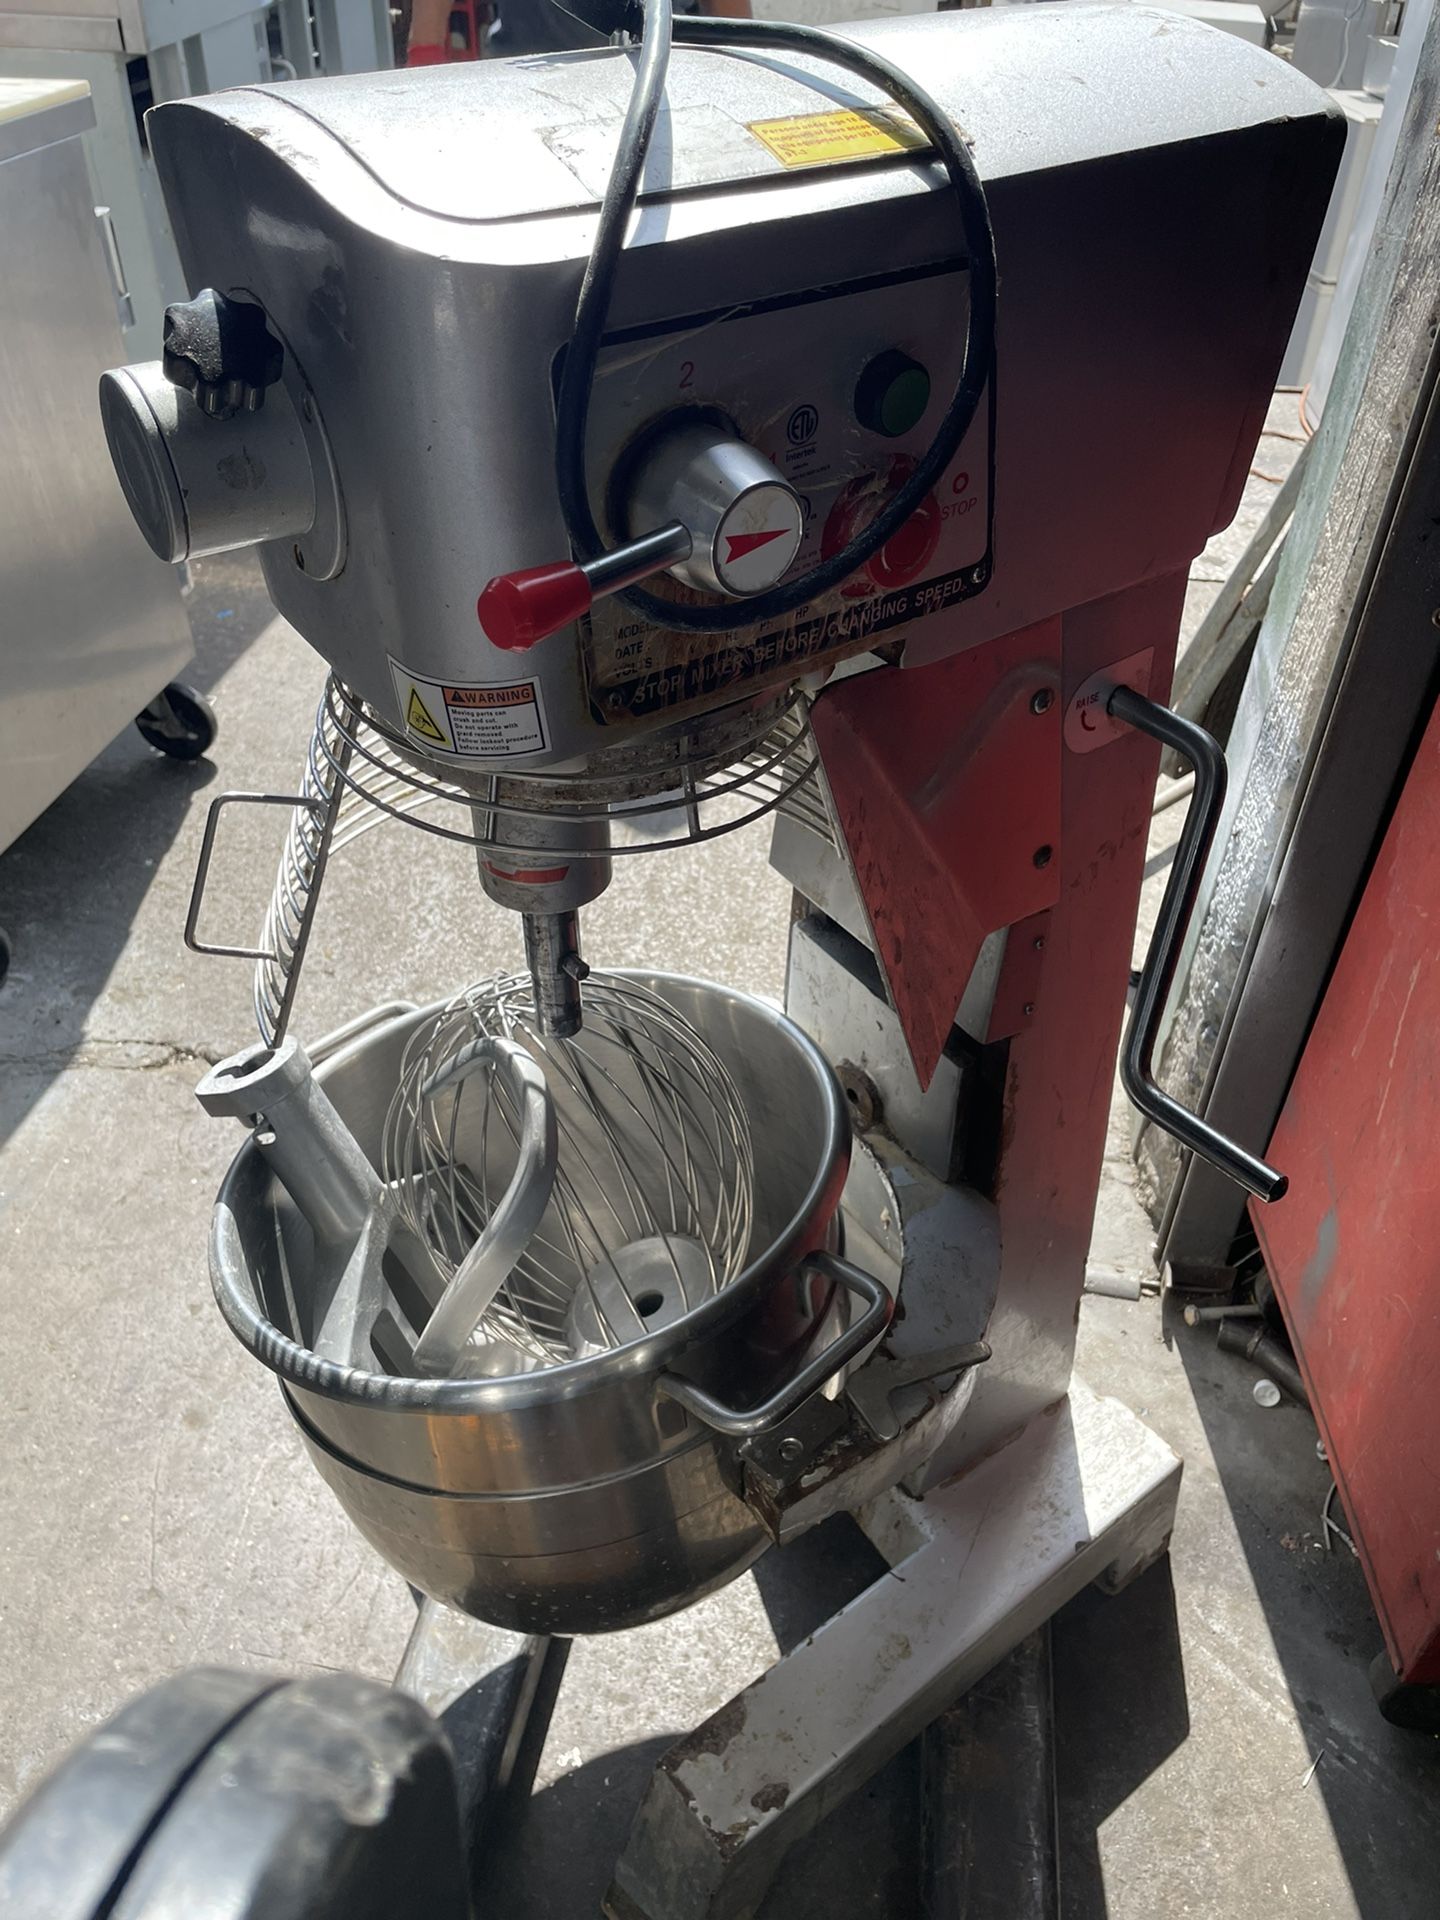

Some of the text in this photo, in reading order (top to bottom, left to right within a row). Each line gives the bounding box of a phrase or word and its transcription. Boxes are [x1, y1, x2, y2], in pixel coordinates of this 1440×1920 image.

[679, 361, 694, 389] 2
[785, 446, 817, 463] Intertek
[941, 497, 978, 521] STOP
[795, 606, 809, 619] HP
[465, 688, 530, 703] WARNING
[634, 674, 681, 705] STOP
[1075, 691, 1100, 710] RAISE
[451, 709, 474, 717] Moving
[506, 734, 538, 744] procedure
